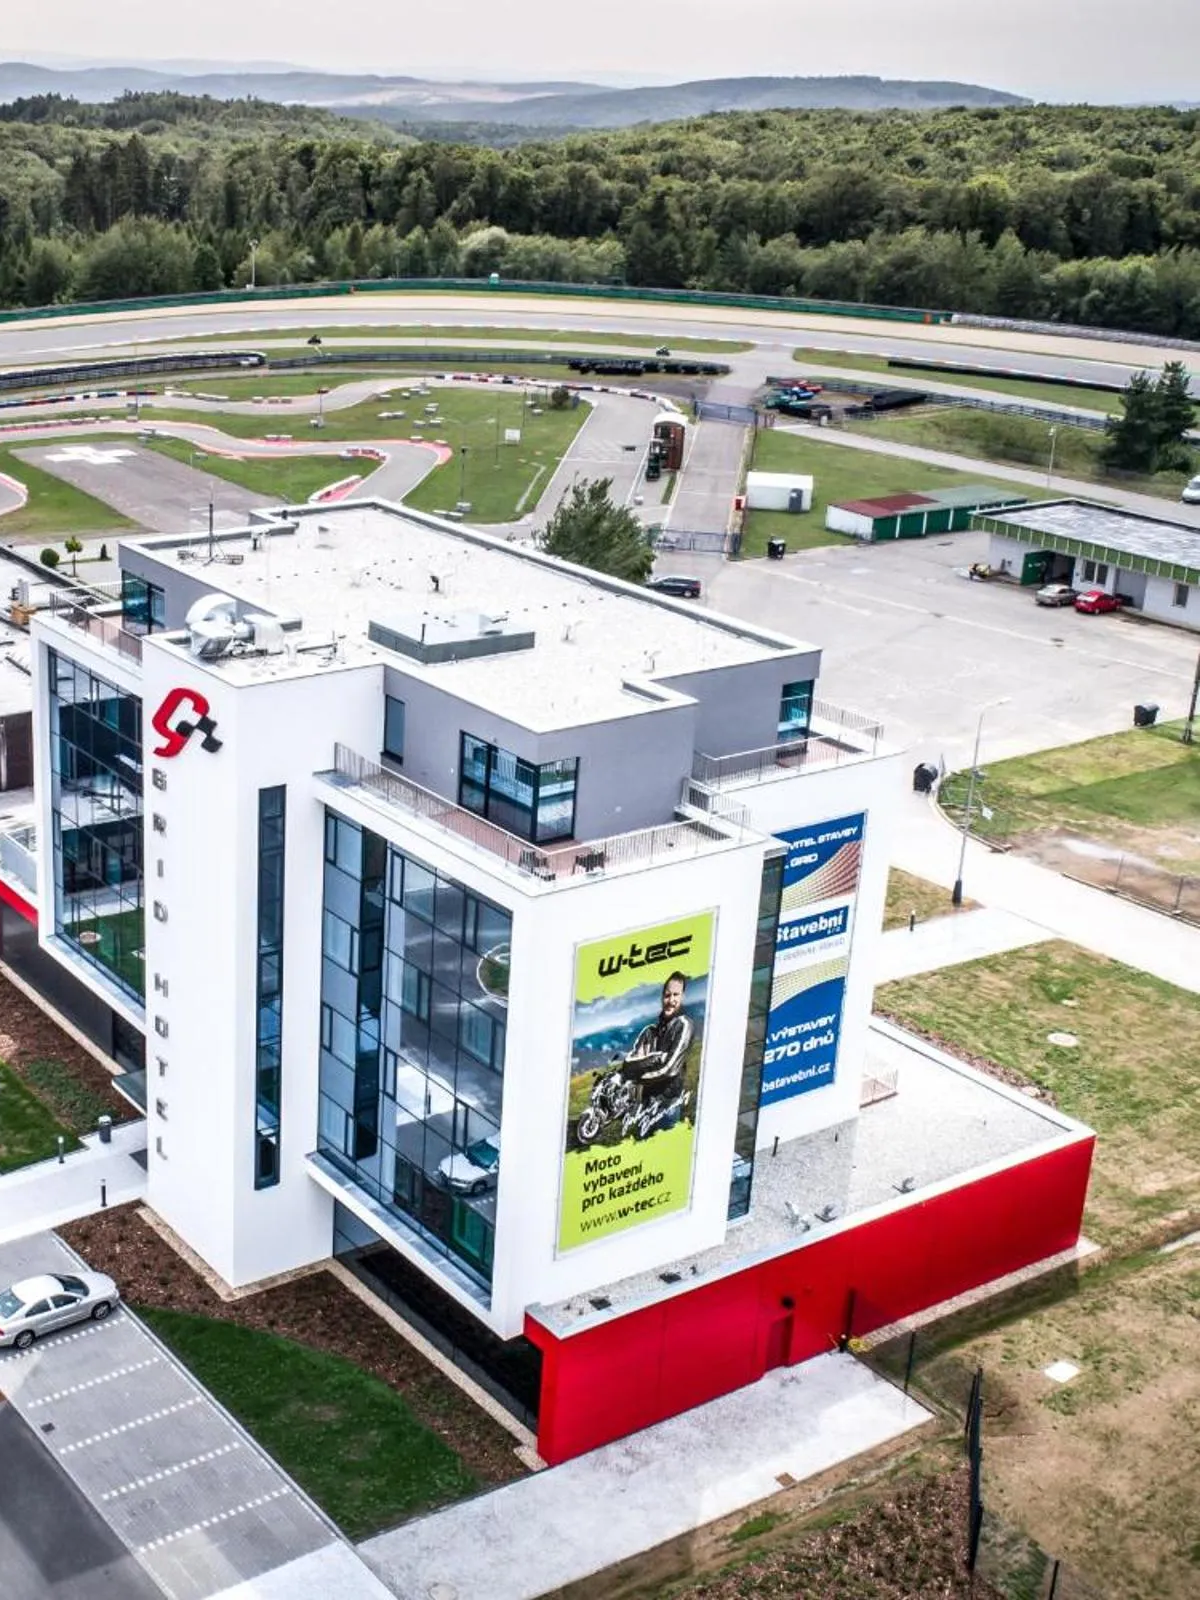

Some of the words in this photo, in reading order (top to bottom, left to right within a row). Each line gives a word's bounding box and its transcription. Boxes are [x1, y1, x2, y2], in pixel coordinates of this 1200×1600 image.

[154, 973, 169, 1160] HOTEL
[764, 1041, 801, 1065] 270
[582, 1160, 643, 1194] vybavení
[584, 1154, 622, 1176] Moto
[581, 1193, 605, 1213] pro
[608, 1172, 664, 1201] každého
[580, 1191, 672, 1233] www.w-tec.cz
